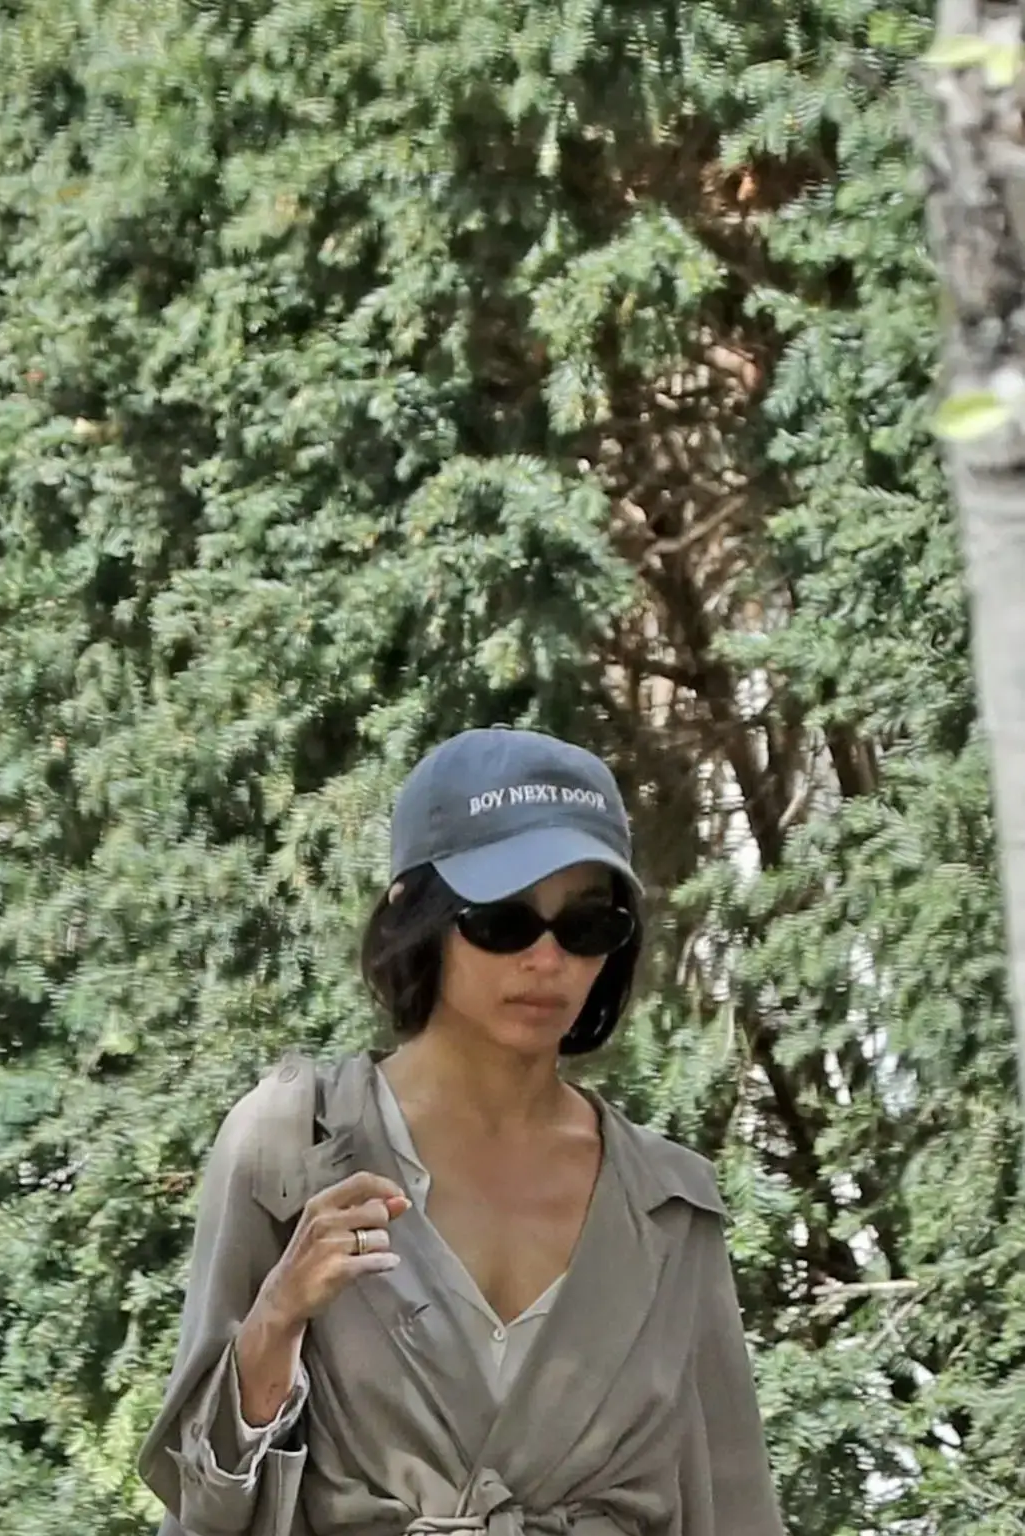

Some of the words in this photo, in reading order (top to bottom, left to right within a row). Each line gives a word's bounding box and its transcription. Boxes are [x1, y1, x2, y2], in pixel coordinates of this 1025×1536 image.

[469, 788, 506, 816] BOY
[509, 784, 557, 806] NEXT
[561, 787, 607, 812] DOOR
